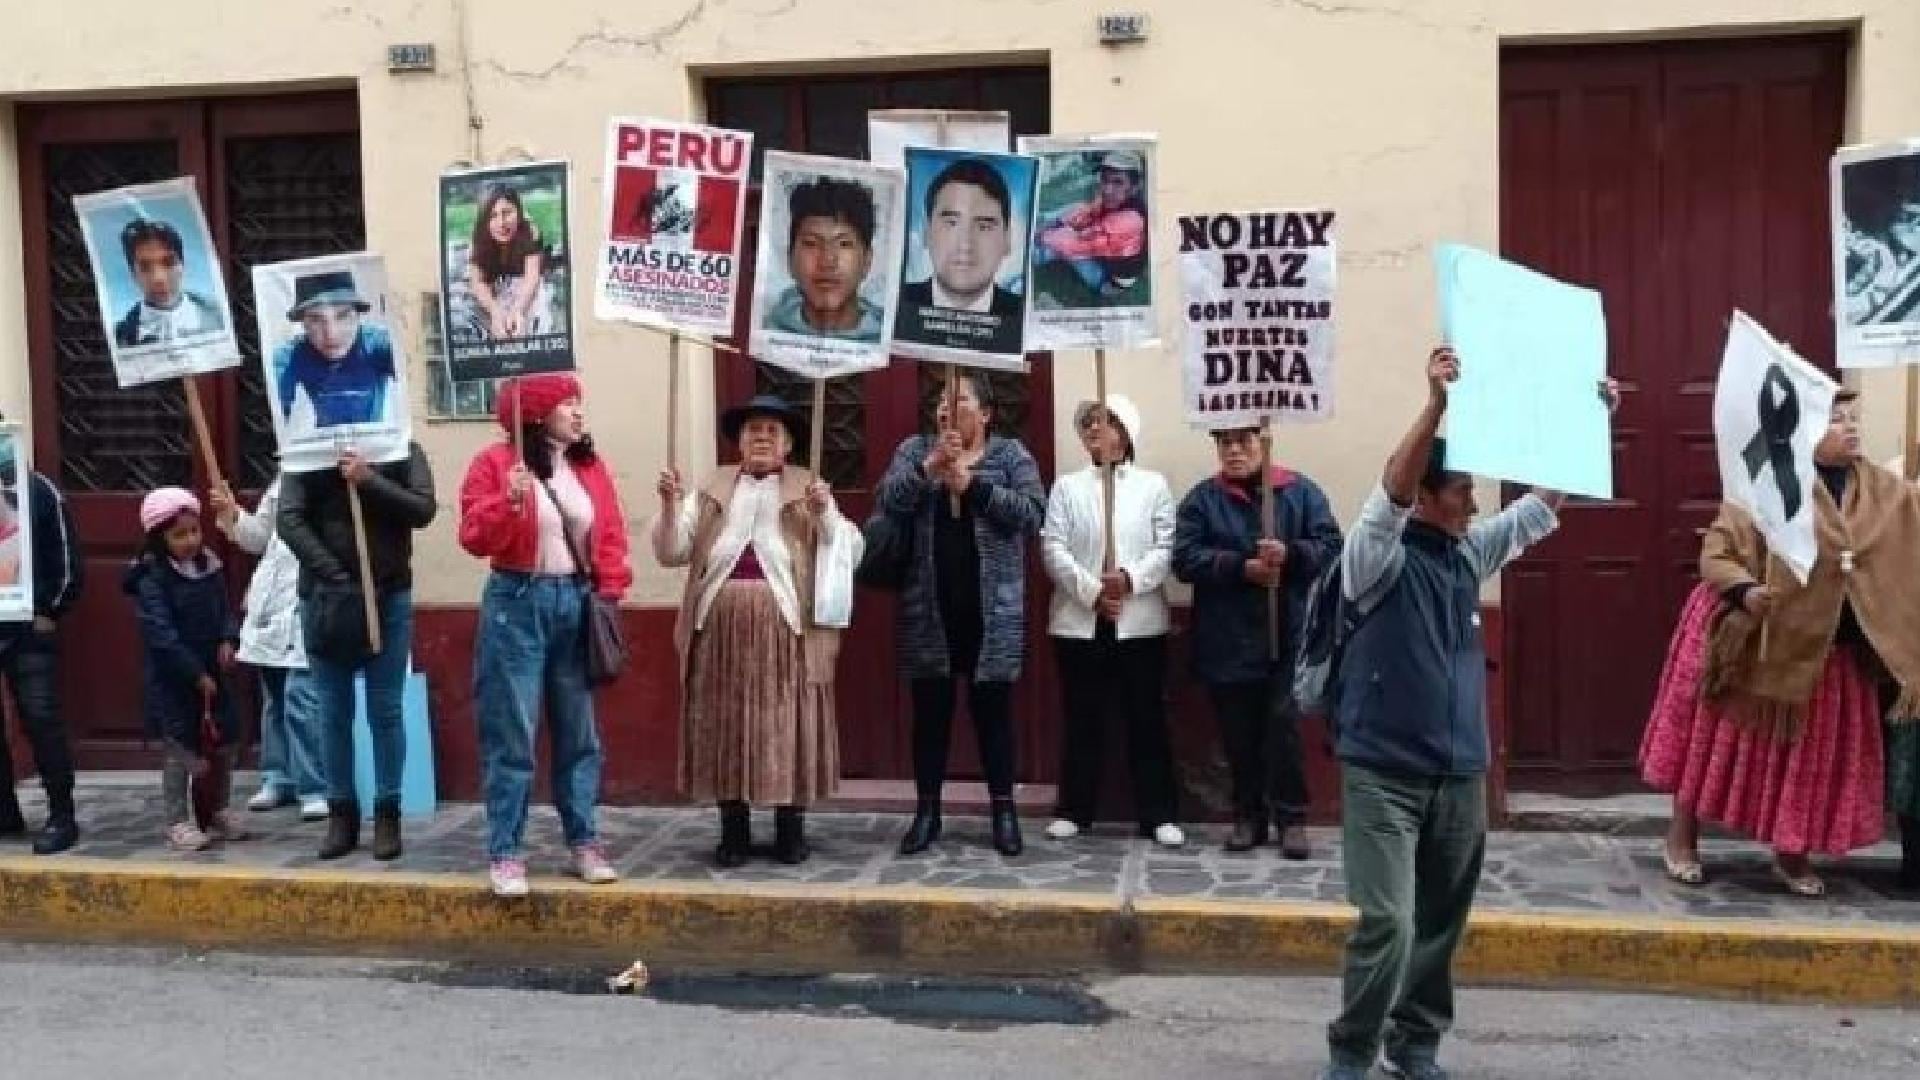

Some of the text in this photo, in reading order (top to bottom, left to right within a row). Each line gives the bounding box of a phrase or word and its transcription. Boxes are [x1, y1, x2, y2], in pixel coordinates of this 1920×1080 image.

[617, 126, 744, 175] PERÚ
[1178, 211, 1336, 252] NO HAY
[608, 244, 732, 278] MÁS DE 60
[1222, 253, 1308, 289] PAZ
[608, 266, 730, 294] ASESINADOS
[1188, 300, 1233, 322] CON
[1203, 349, 1313, 386] DINA
